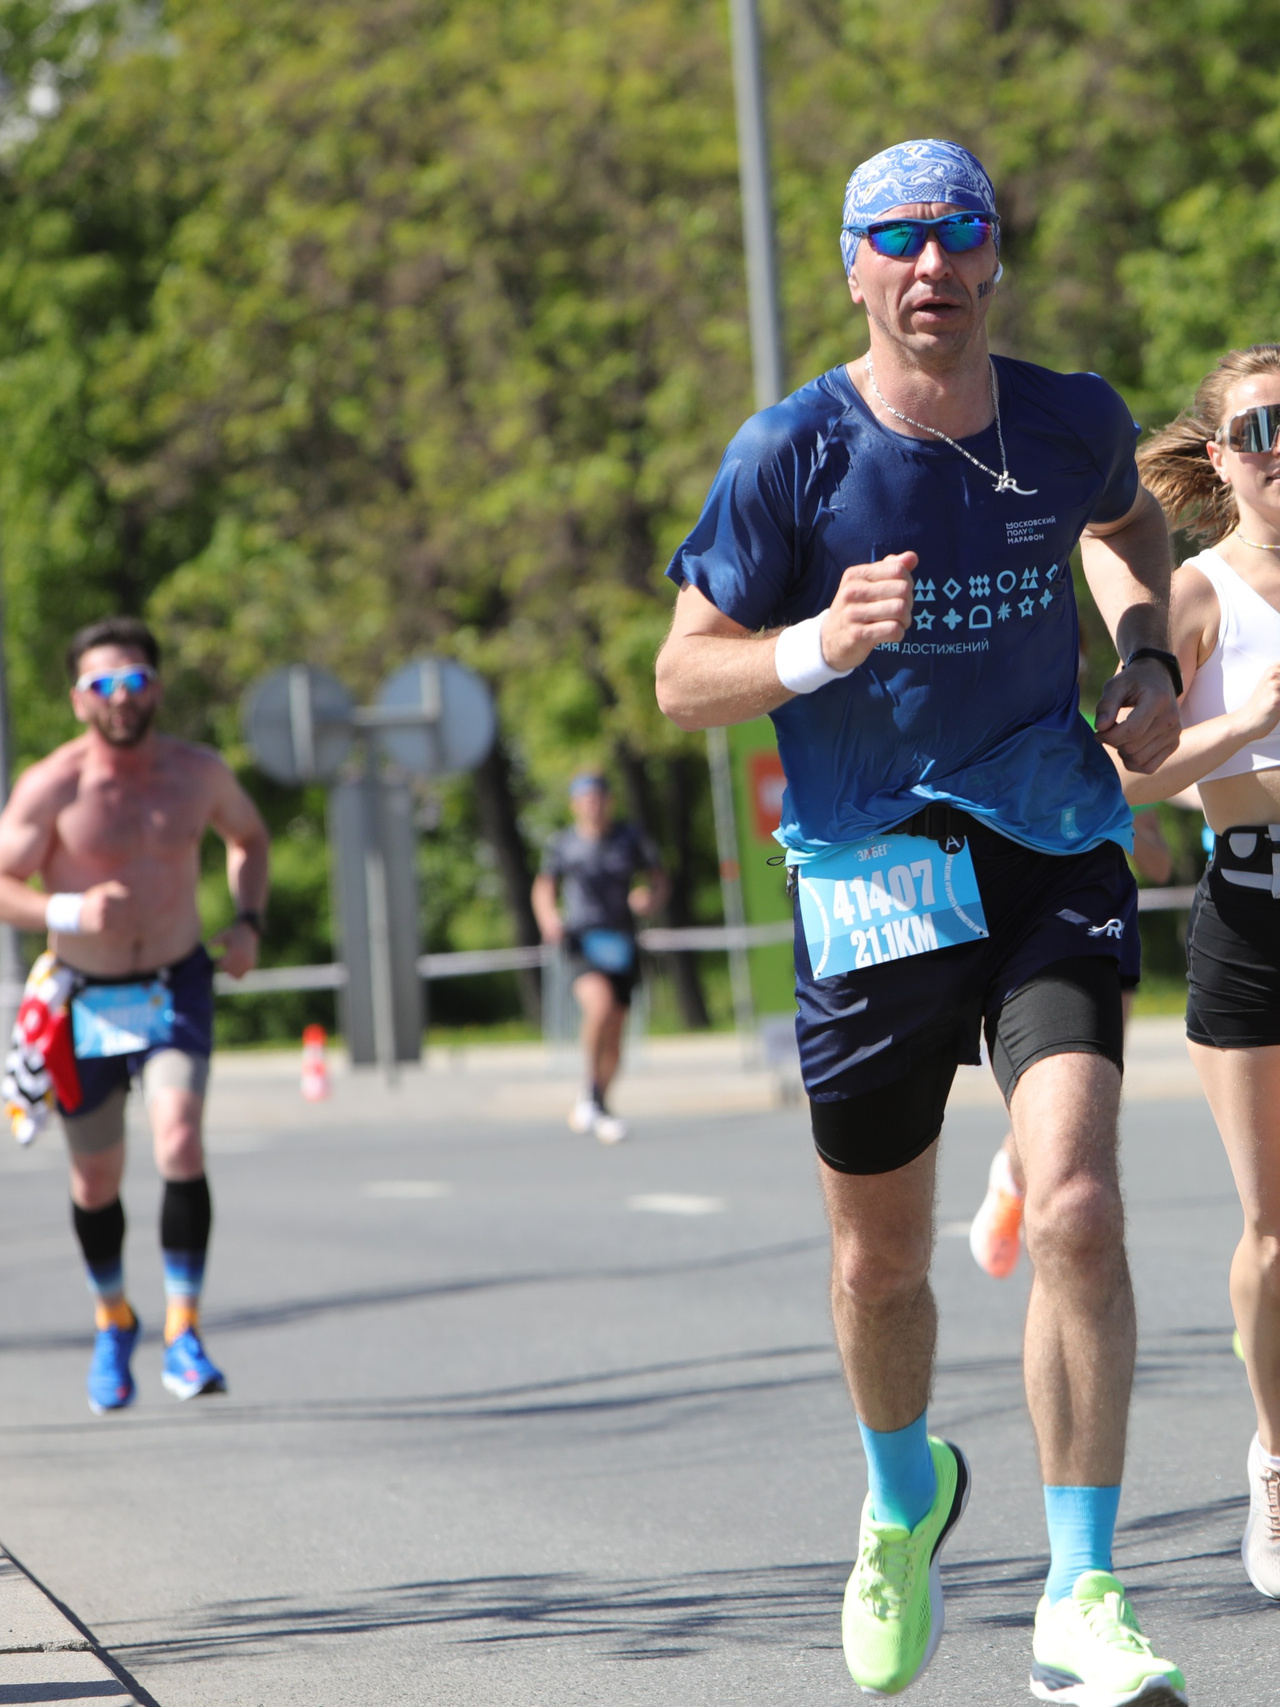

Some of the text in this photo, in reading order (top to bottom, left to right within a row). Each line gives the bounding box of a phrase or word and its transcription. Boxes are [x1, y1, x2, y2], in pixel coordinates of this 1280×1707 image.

[1005, 515, 1056, 530] МОСКОВСКИЙ
[1006, 528, 1028, 537] ПОЛУ
[1007, 533, 1045, 545] МАРАФОН
[901, 638, 990, 655] ДОСТИЖЕНИЙ
[833, 858, 936, 926] 41407
